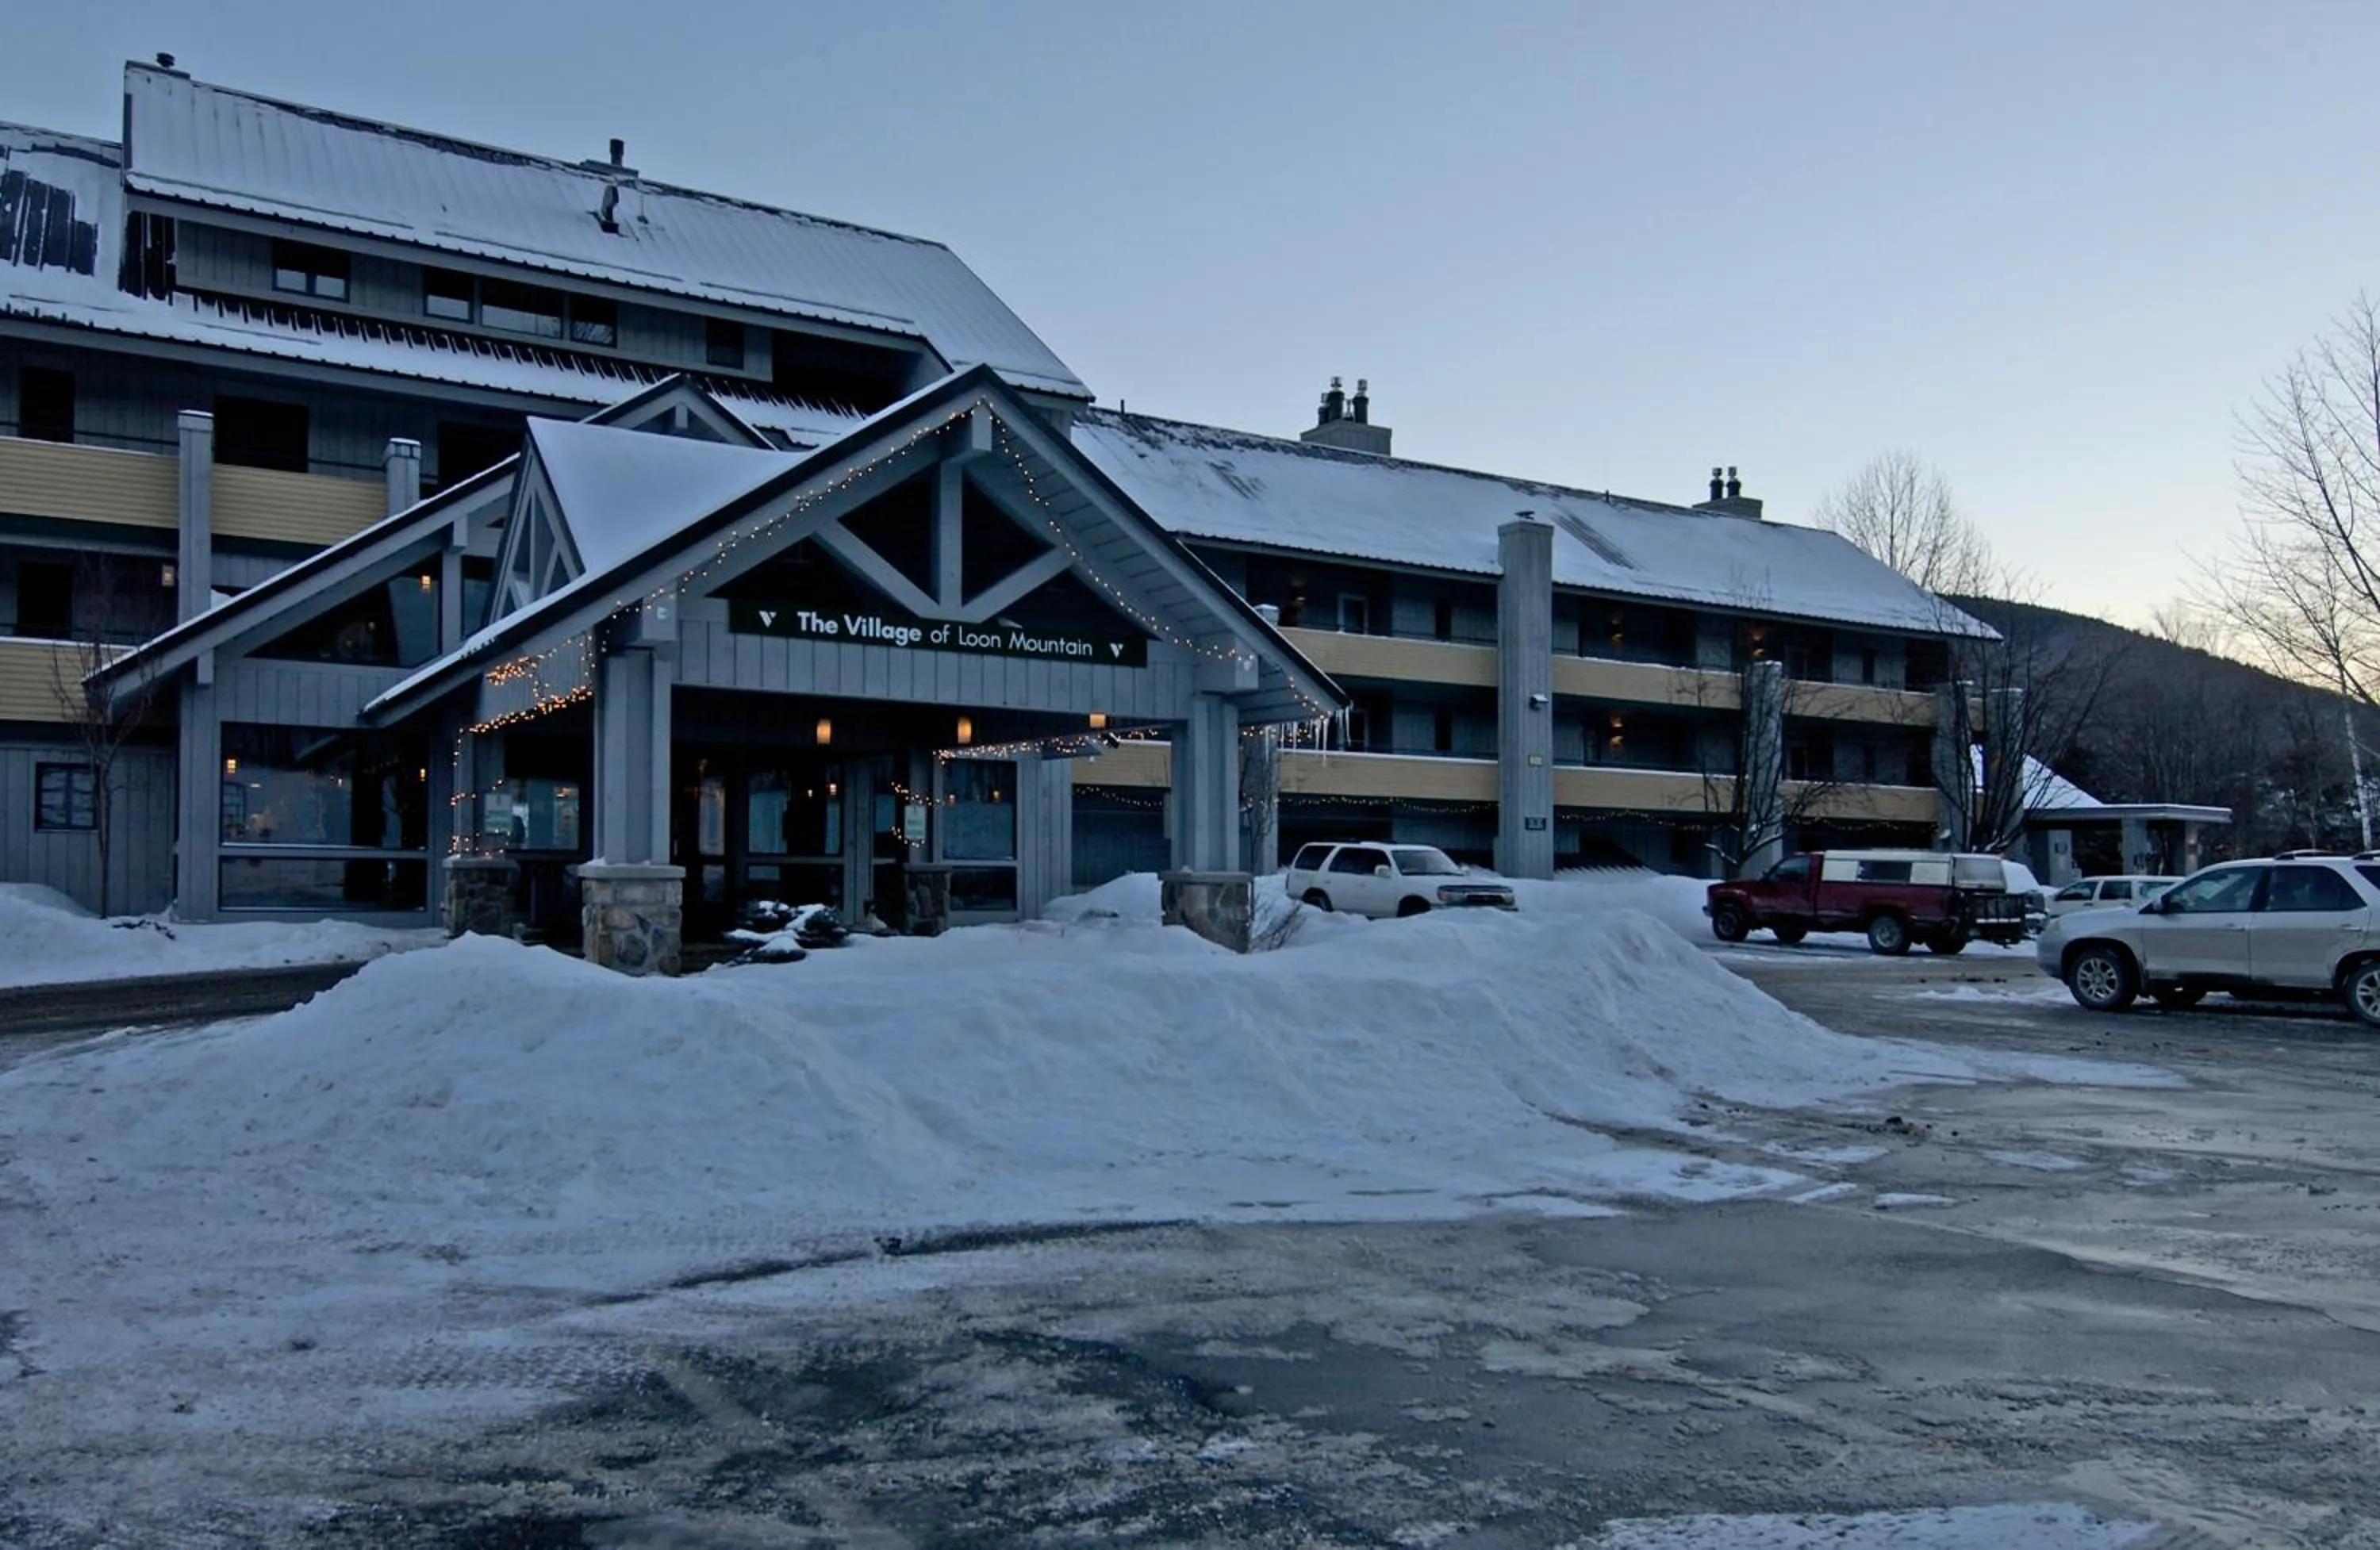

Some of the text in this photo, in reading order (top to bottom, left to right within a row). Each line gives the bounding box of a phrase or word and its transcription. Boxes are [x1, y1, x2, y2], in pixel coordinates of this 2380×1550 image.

[797, 610, 1093, 656] The Village of Loon Mountain
